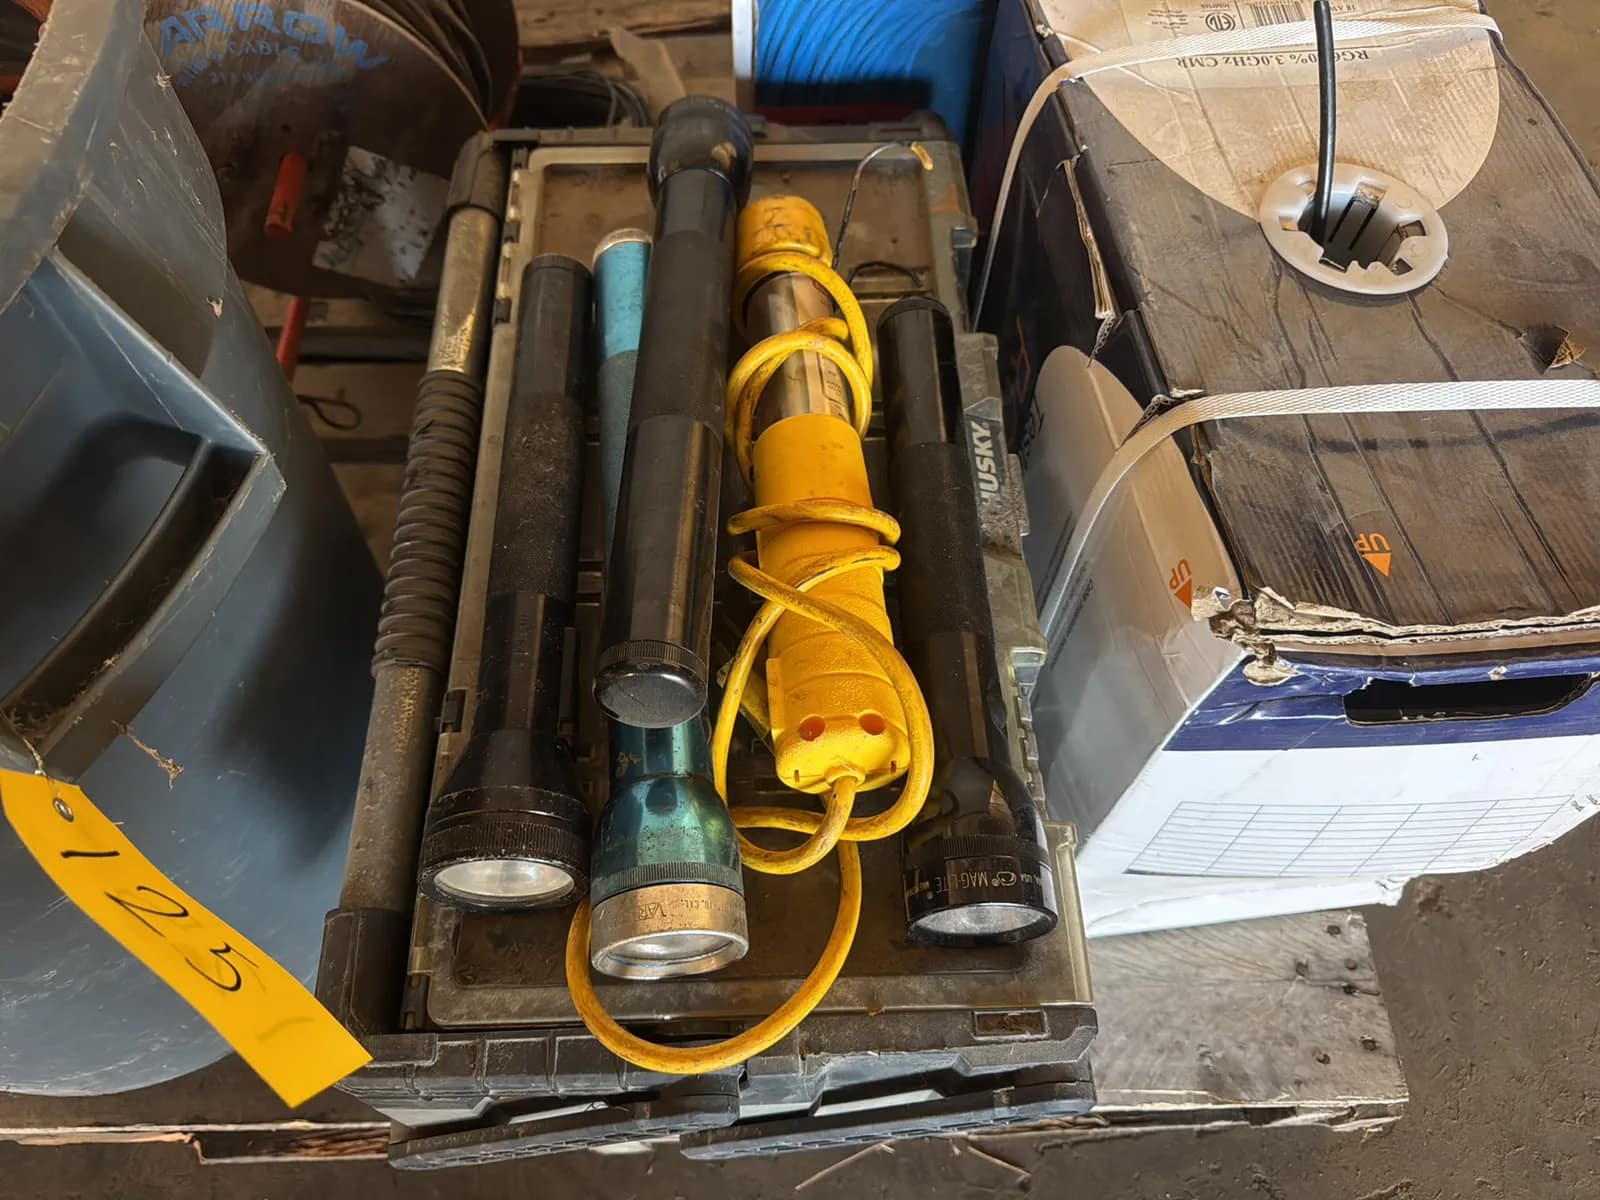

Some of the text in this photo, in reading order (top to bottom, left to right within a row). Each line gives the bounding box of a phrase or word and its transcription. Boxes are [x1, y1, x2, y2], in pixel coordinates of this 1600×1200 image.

[160, 2, 390, 70] ARROW
[1175, 57, 1218, 69] CMR
[1222, 55, 1285, 68] 3.0GHz
[1289, 53, 1317, 65] 0%
[1355, 532, 1391, 552] UP
[1169, 559, 1192, 589] UP
